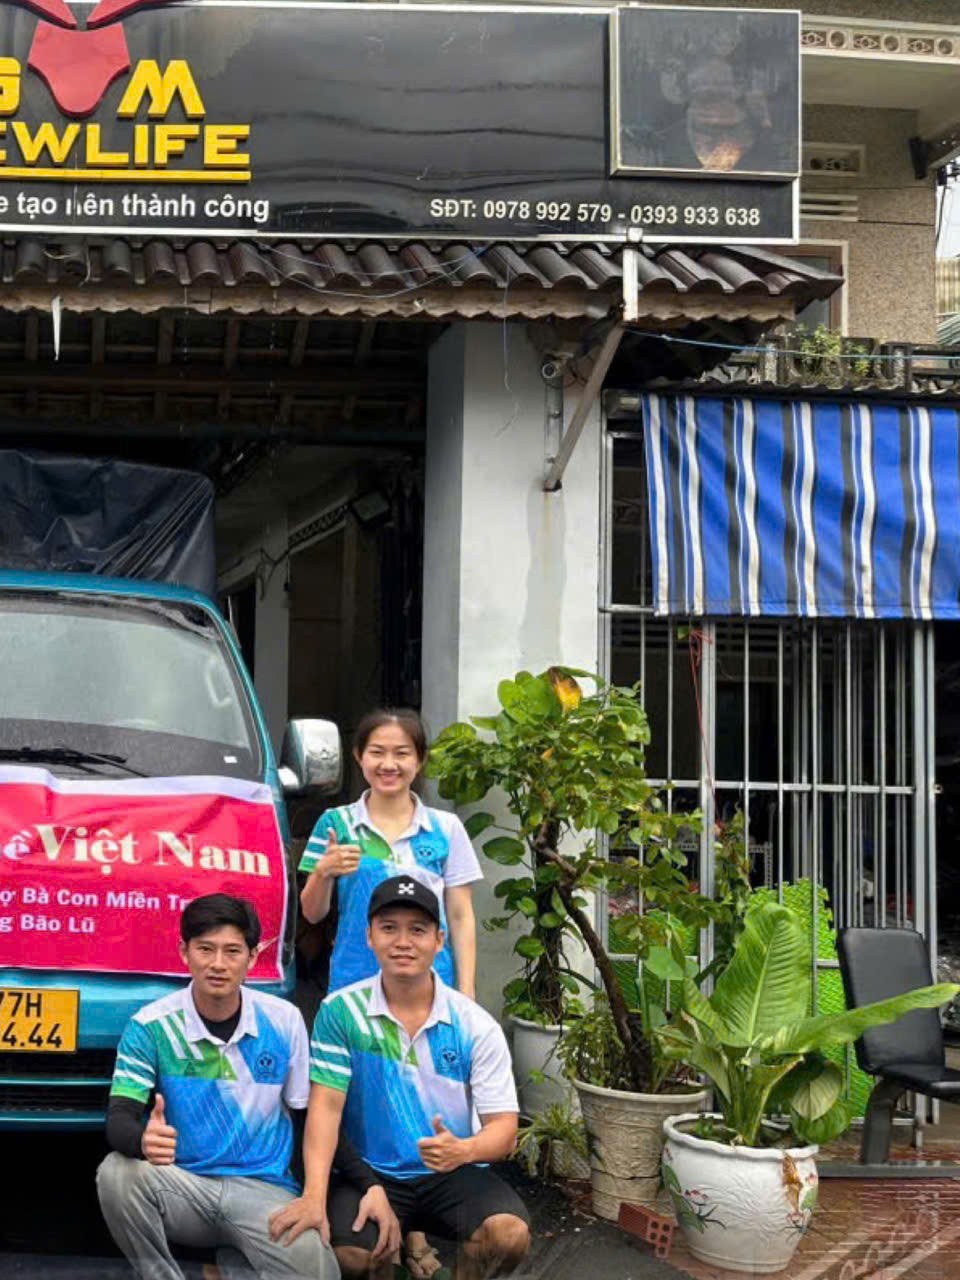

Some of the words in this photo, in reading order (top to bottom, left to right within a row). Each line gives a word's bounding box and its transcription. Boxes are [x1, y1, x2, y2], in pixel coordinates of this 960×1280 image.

[16, 193, 57, 219] tạo
[122, 193, 196, 218] thành
[204, 195, 270, 224] công
[430, 199, 477, 218] SĐT:
[483, 200, 530, 220] 0978
[536, 202, 571, 221] 992
[577, 203, 611, 222] 579
[630, 205, 677, 224] 0393
[683, 206, 719, 225] 933
[725, 207, 760, 226] 638
[34, 824, 141, 876] Việt
[154, 830, 271, 877] Nam
[23, 887, 49, 905] Bà
[57, 888, 98, 906] Con
[21, 913, 61, 932] Bão
[69, 916, 95, 933] Lũ
